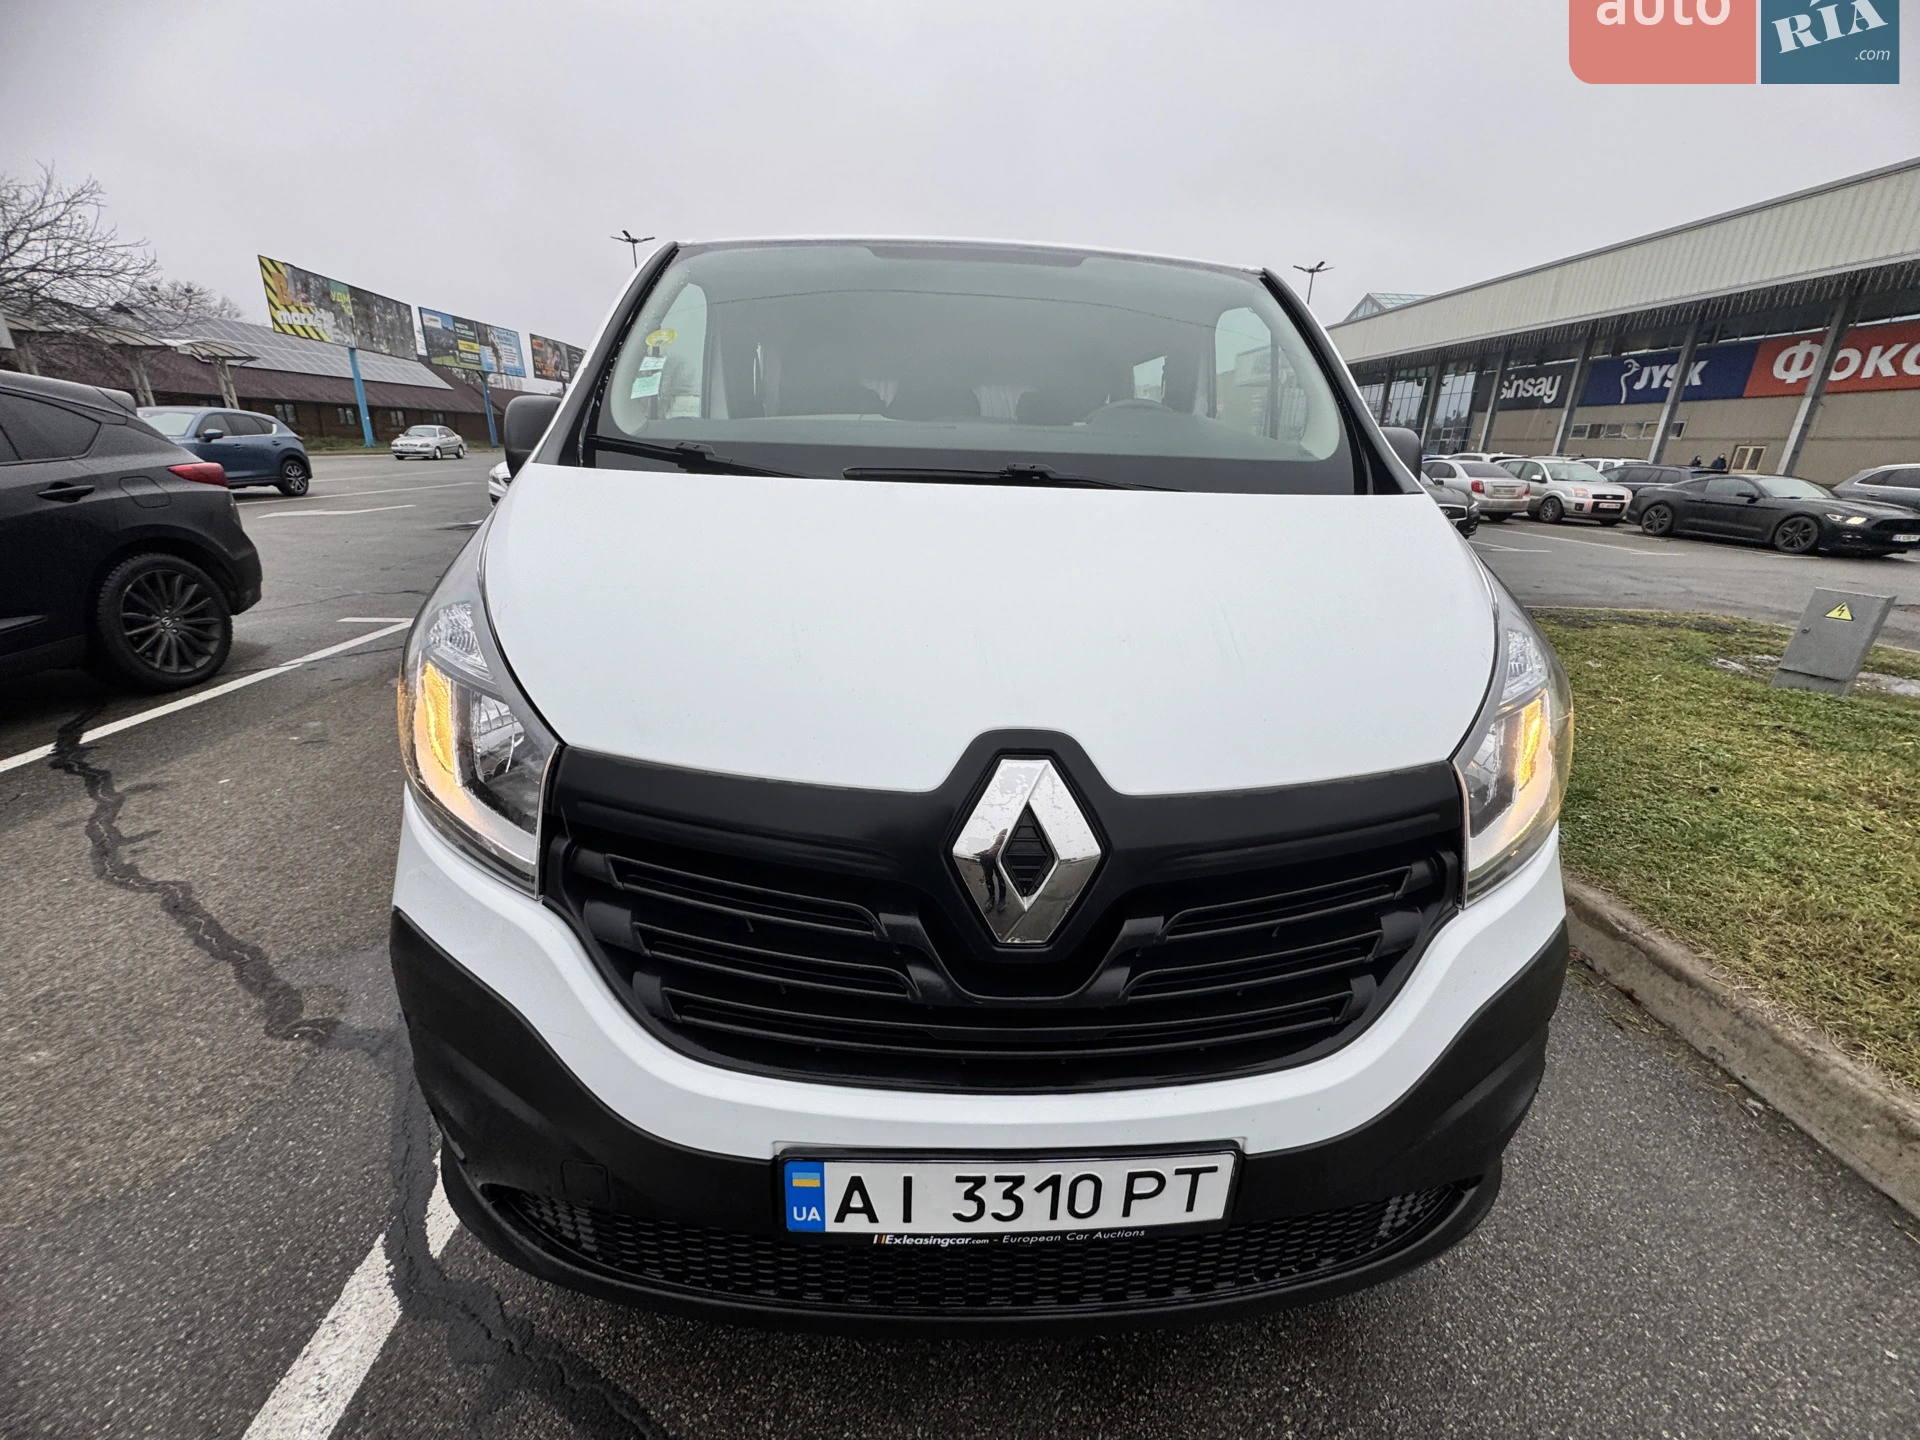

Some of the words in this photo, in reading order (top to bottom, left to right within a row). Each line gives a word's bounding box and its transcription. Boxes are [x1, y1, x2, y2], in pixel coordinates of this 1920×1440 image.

[952, 1173, 1102, 1223] 3310
[793, 1206, 821, 1221] UA
[1002, 1234, 1061, 1245] European
[1066, 1232, 1090, 1241] Car
[1093, 1229, 1146, 1240] Auctions
